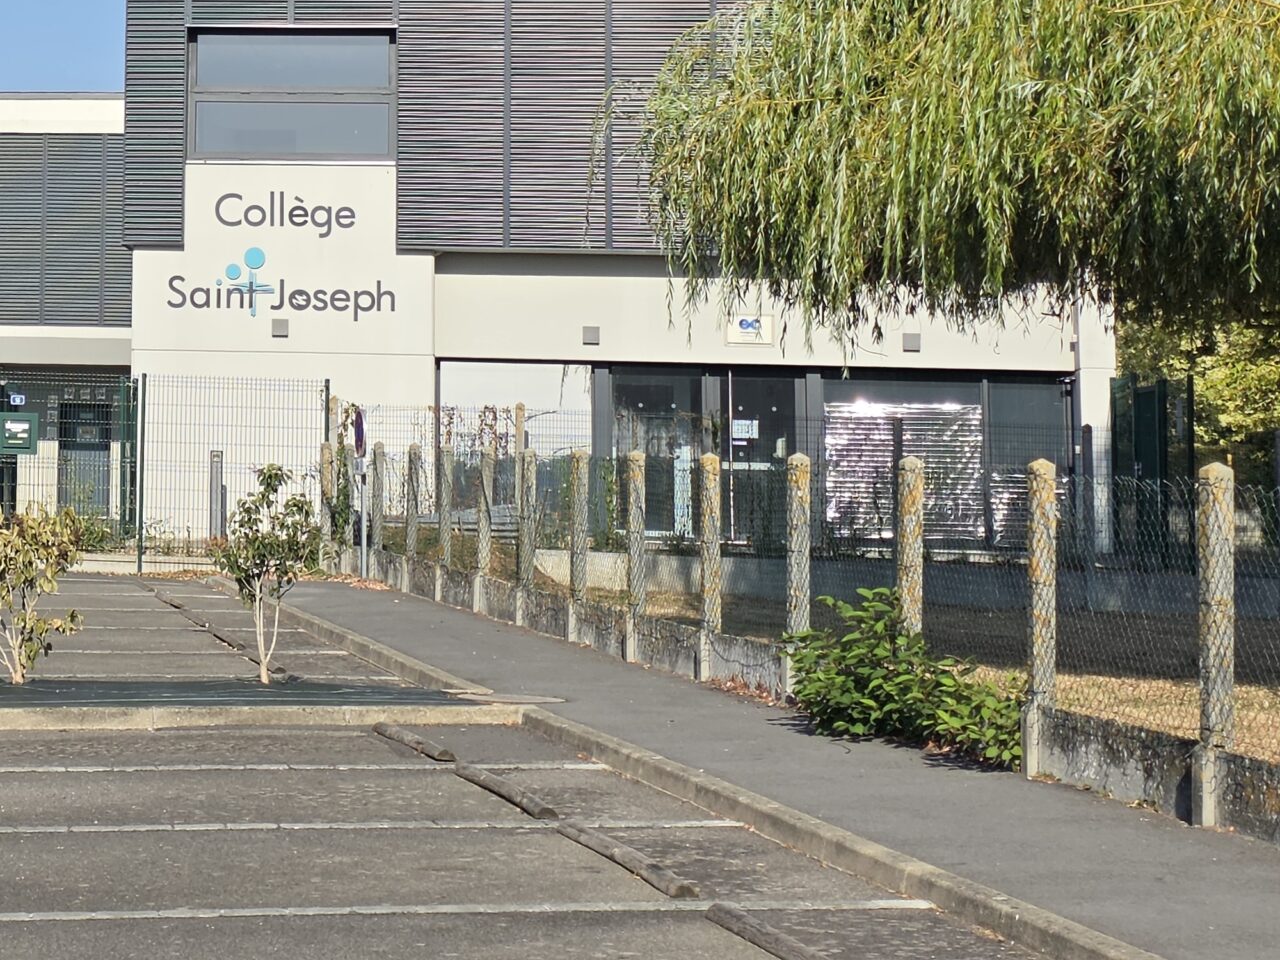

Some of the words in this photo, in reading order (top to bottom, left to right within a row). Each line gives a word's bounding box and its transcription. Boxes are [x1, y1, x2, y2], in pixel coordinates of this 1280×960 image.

[215, 191, 355, 238] Collège
[167, 275, 256, 309] Saint
[270, 279, 396, 321] Joseph
